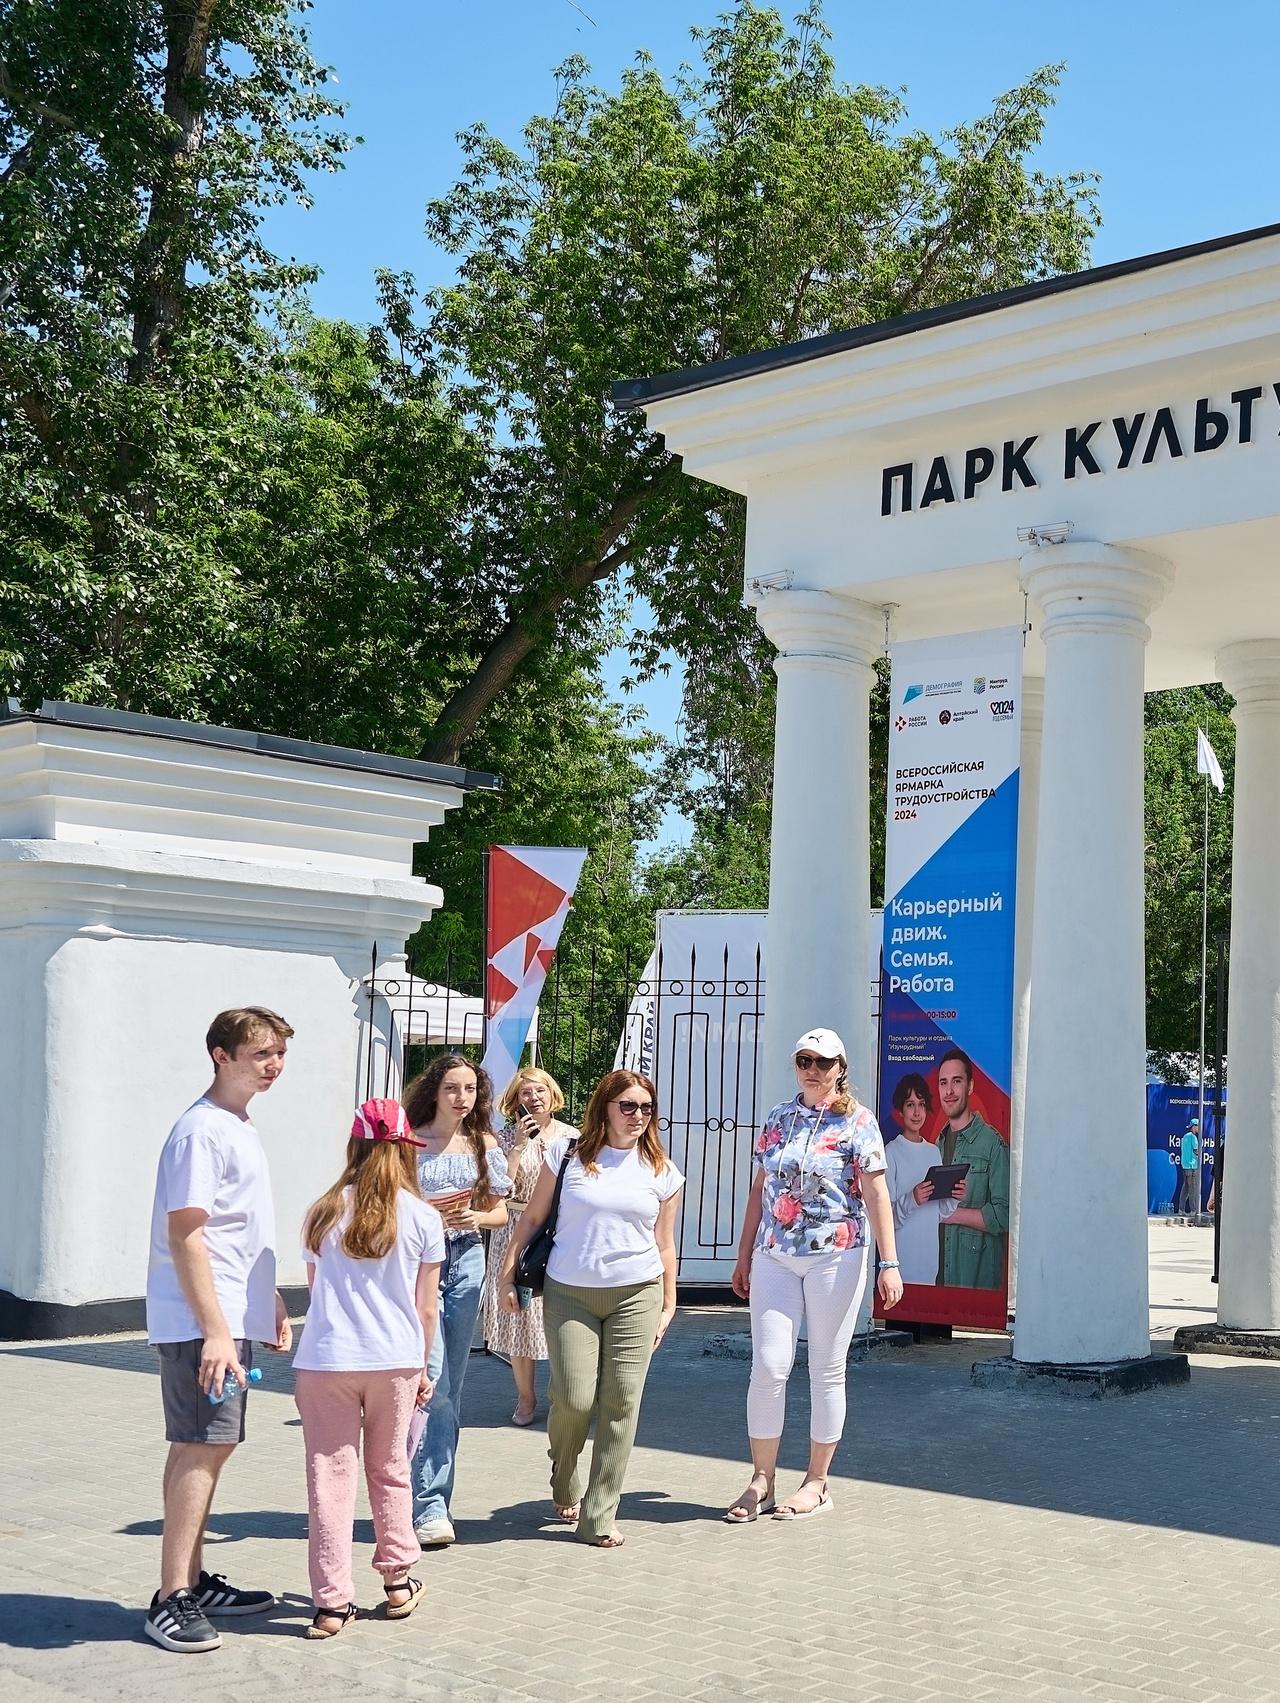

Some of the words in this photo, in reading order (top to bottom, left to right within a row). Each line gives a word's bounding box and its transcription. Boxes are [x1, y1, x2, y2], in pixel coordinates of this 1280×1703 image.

[881, 435, 1039, 516] ПАРК
[926, 681, 963, 692] ДЕМОГРАФИЯ
[994, 700, 1014, 715] 2024
[896, 761, 984, 779] ВСЕРОССИЙСКАЯ
[895, 779, 944, 793] ЯРМАРКА
[895, 788, 996, 806] ТРУДОУСТРОЙСТВА
[894, 809, 917, 820] 2024
[891, 892, 1003, 919] Карьерный
[891, 926, 947, 944] движ.
[890, 950, 954, 968] Семья.
[889, 973, 954, 993] Работа
